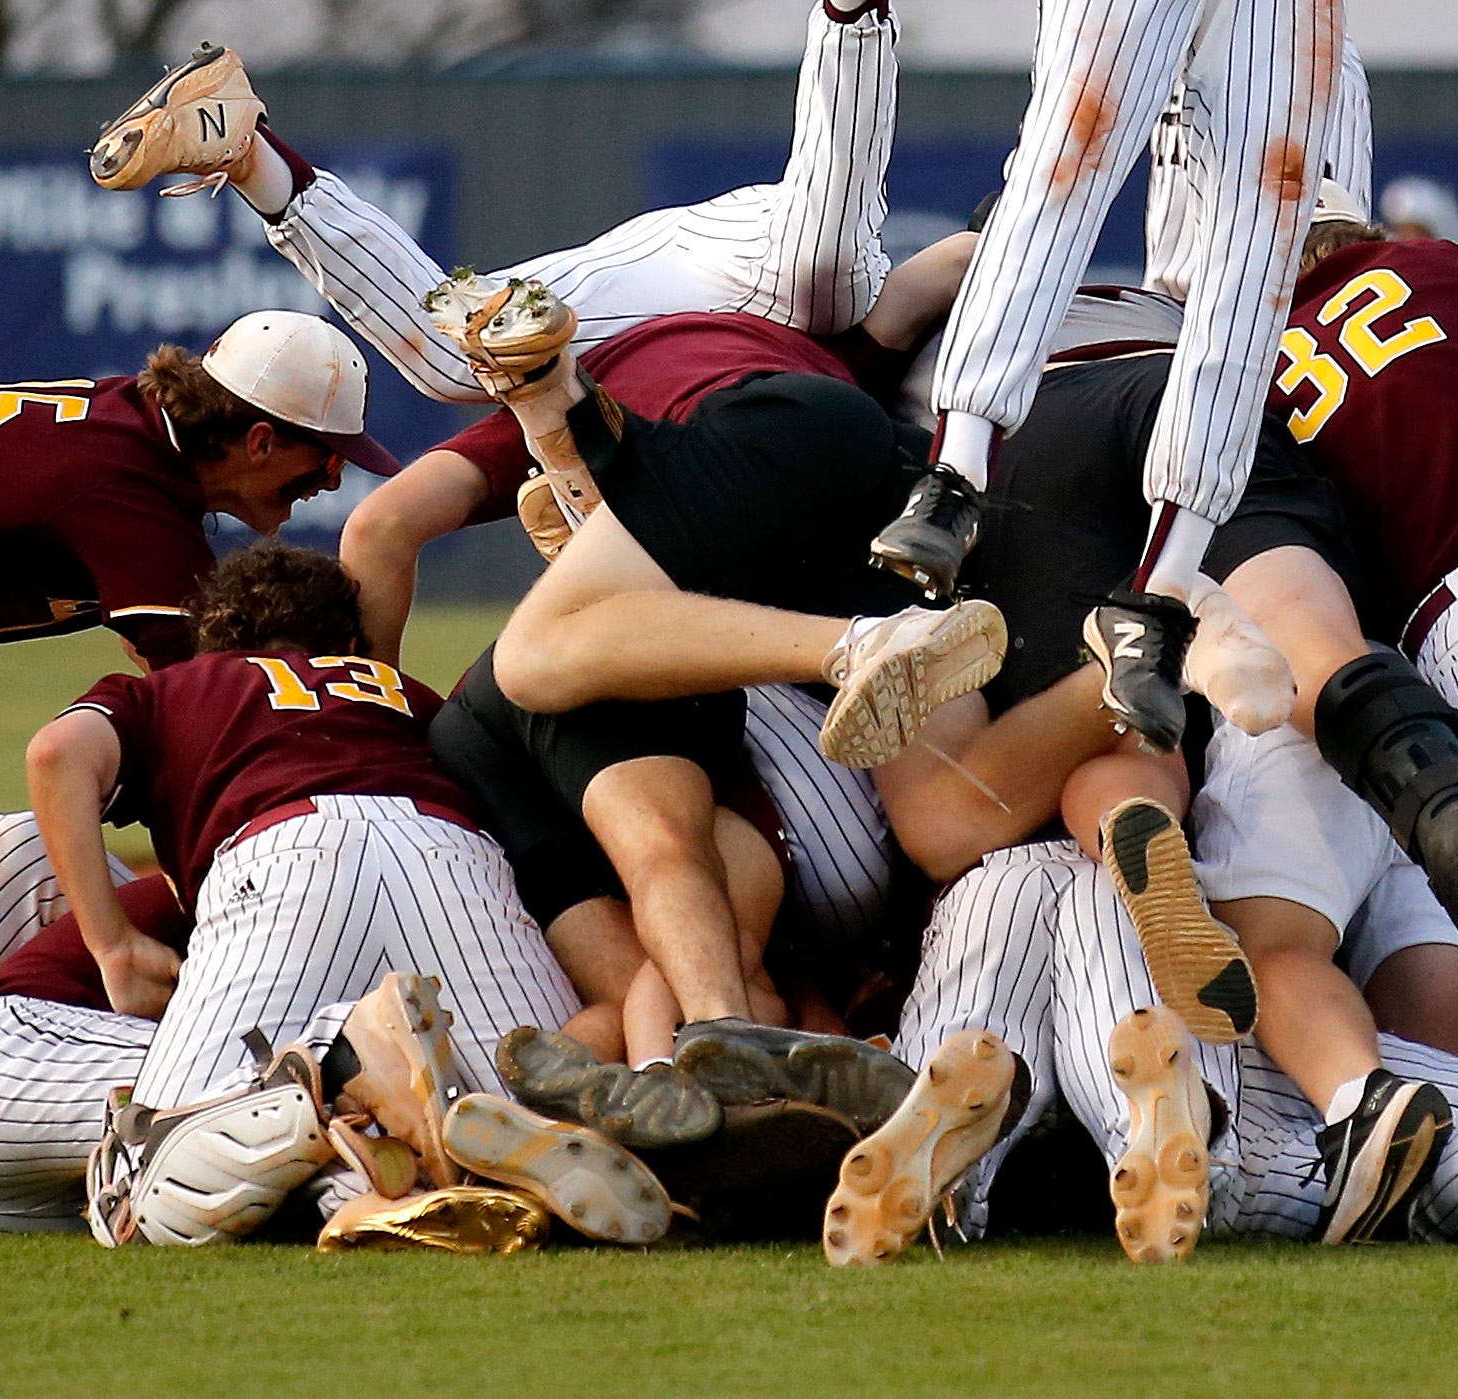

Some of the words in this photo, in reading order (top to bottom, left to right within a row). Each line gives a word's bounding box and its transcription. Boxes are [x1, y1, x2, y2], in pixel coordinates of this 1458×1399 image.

[197, 103, 227, 141] N
[1275, 268, 1448, 445] 32
[1113, 621, 1145, 658] N
[245, 655, 415, 718] 13
